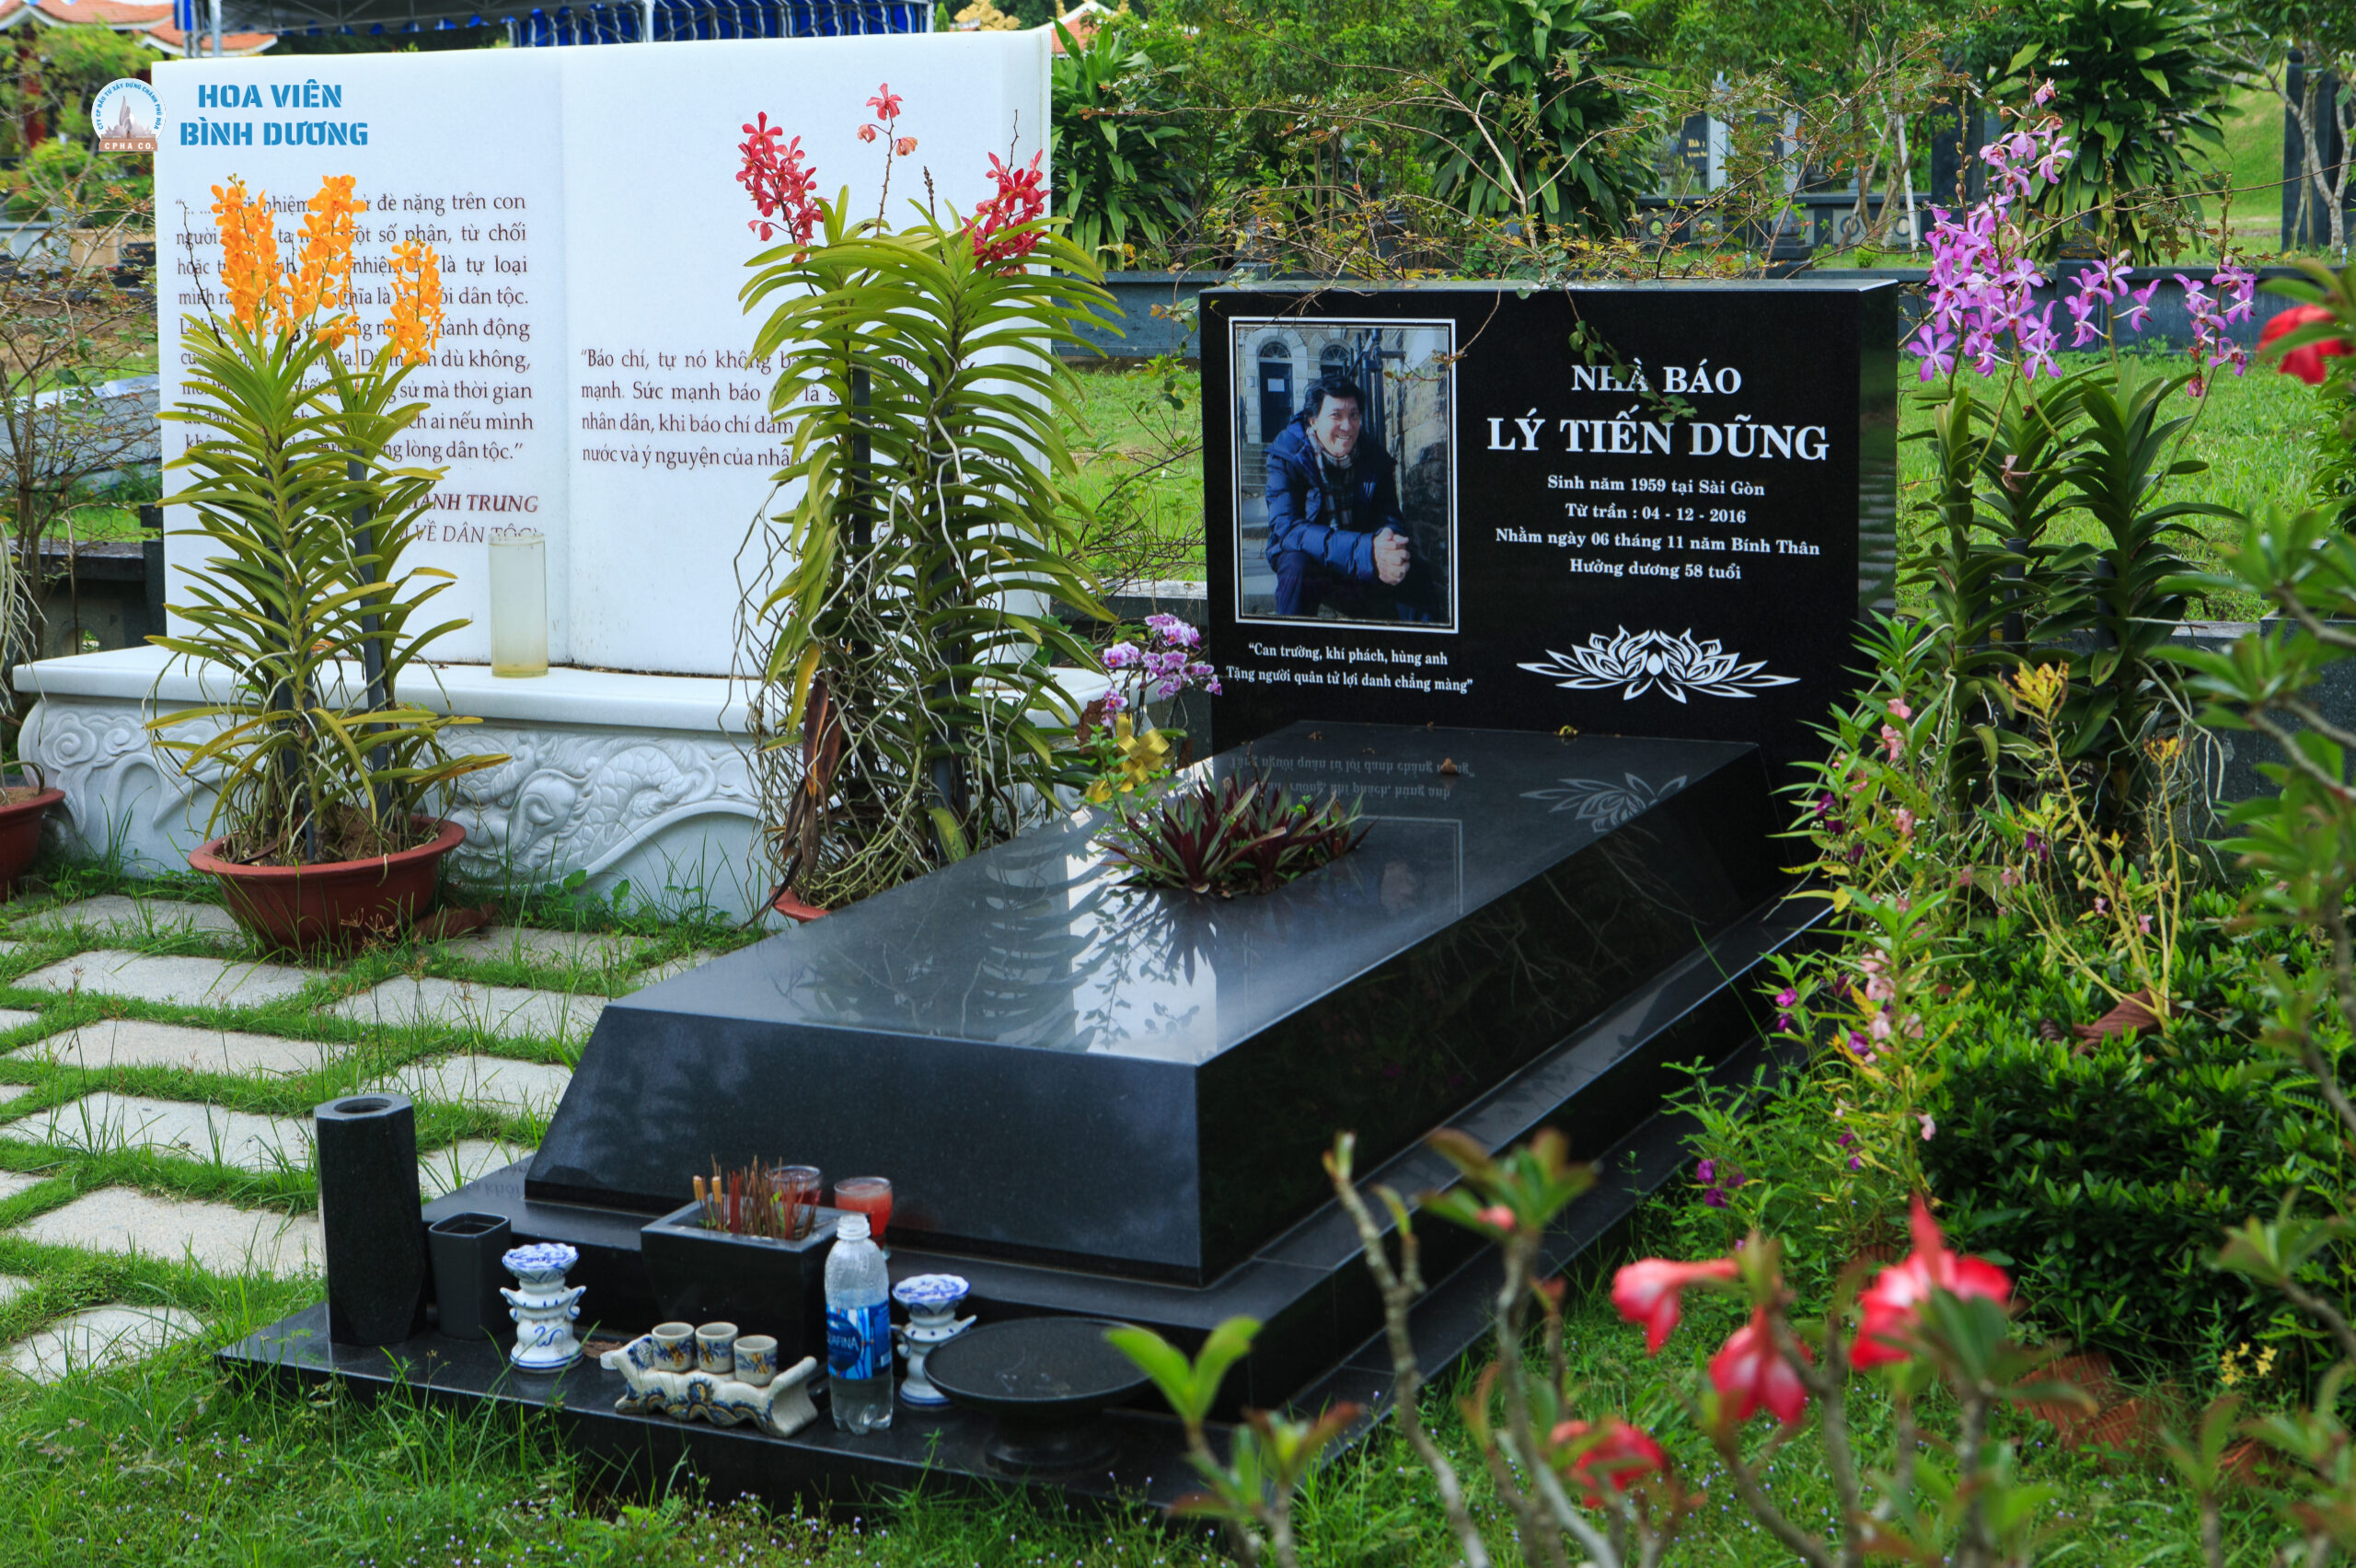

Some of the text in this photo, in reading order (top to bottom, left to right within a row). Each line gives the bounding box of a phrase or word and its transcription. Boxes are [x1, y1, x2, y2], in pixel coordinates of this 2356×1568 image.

[377, 194, 396, 211] đè
[403, 195, 445, 216] nặng
[453, 192, 486, 210] trên
[493, 198, 525, 209] con
[177, 227, 217, 251] người
[379, 224, 397, 242] số
[462, 224, 479, 241] từ
[489, 222, 525, 241] chối
[442, 255, 456, 272] là
[467, 258, 484, 275] tự
[494, 255, 526, 276] loại
[378, 287, 390, 304] là
[459, 287, 491, 304] dân
[497, 286, 527, 307] tộc.
[483, 317, 530, 341] động
[442, 350, 464, 366] dù
[469, 350, 530, 373] không,
[622, 350, 649, 369] chí,
[659, 352, 676, 370] tự
[685, 350, 706, 367] nó
[1663, 359, 1741, 394] BÁO
[398, 382, 419, 398] sử
[423, 381, 449, 398] mà
[455, 381, 488, 398] thời
[493, 382, 532, 404] gian
[633, 382, 663, 398] Sức
[672, 382, 720, 403] mạnh
[730, 383, 760, 401] báo
[431, 413, 445, 429] ai
[449, 411, 480, 429] nếu
[486, 412, 533, 430] mình
[583, 412, 616, 430] nhân
[620, 413, 654, 433] dân,
[660, 413, 685, 432] khi
[689, 414, 721, 432] báo
[725, 415, 749, 432] chí
[1487, 405, 1830, 460] LÝ TIẾN DŨNG
[407, 440, 442, 464] lòng
[446, 441, 479, 458] dân
[583, 444, 617, 462] nước
[620, 444, 638, 462] và
[642, 445, 652, 468] ý
[656, 446, 720, 470] nguyện
[724, 448, 753, 465] của
[1548, 475, 1764, 495] Sinh năm 1959 tại Sài Gòn
[467, 495, 537, 513] TRUNG
[1565, 503, 1588, 517] Từ
[1593, 502, 1627, 518] trần
[1642, 507, 1659, 519] 04
[1678, 508, 1693, 521] 12
[1710, 509, 1746, 523] 2016
[444, 522, 484, 543] DÂN
[1496, 526, 1819, 555] Nhằm ngày 06 tháng 11 năm Bính Thân
[1570, 559, 1740, 579] Hưởng dương 58 tuổi
[1281, 646, 1322, 661] trường,
[1326, 647, 1345, 660] khí
[1349, 648, 1387, 663] phách,
[1392, 650, 1421, 666] hùng
[1426, 652, 1448, 664] anh
[1227, 666, 1254, 682] Tặng
[1259, 669, 1290, 683] người
[1295, 672, 1322, 685] quân
[1327, 672, 1339, 684] tử
[1344, 674, 1357, 687] lợi
[1362, 674, 1391, 686] danh
[1395, 673, 1430, 692] chẳng
